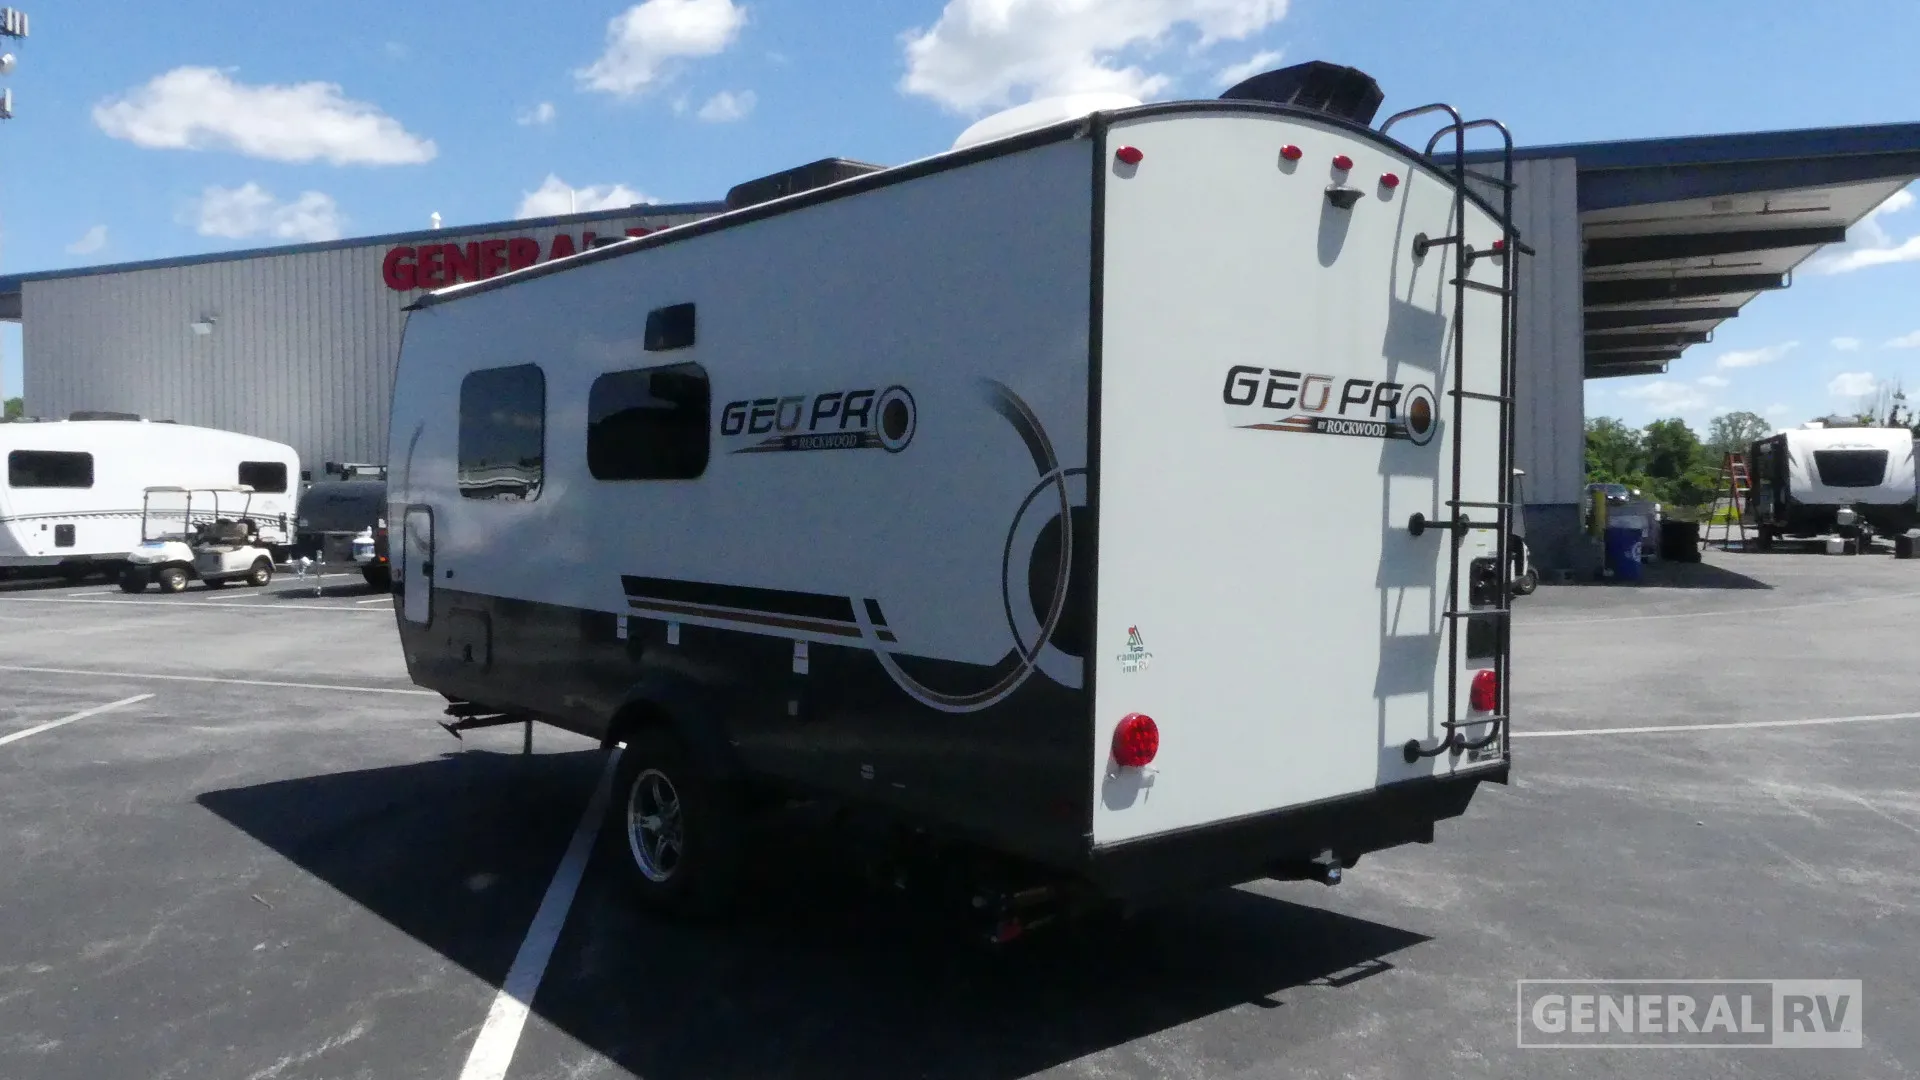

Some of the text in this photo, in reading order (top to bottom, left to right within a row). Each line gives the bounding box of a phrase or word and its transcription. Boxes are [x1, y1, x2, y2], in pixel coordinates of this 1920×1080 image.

[383, 232, 597, 291] GENERA
[1223, 365, 1335, 412] GEO
[721, 396, 806, 436] GEO
[1326, 419, 1387, 437] ROCKWOOD
[800, 434, 858, 449] ROCKWOOD
